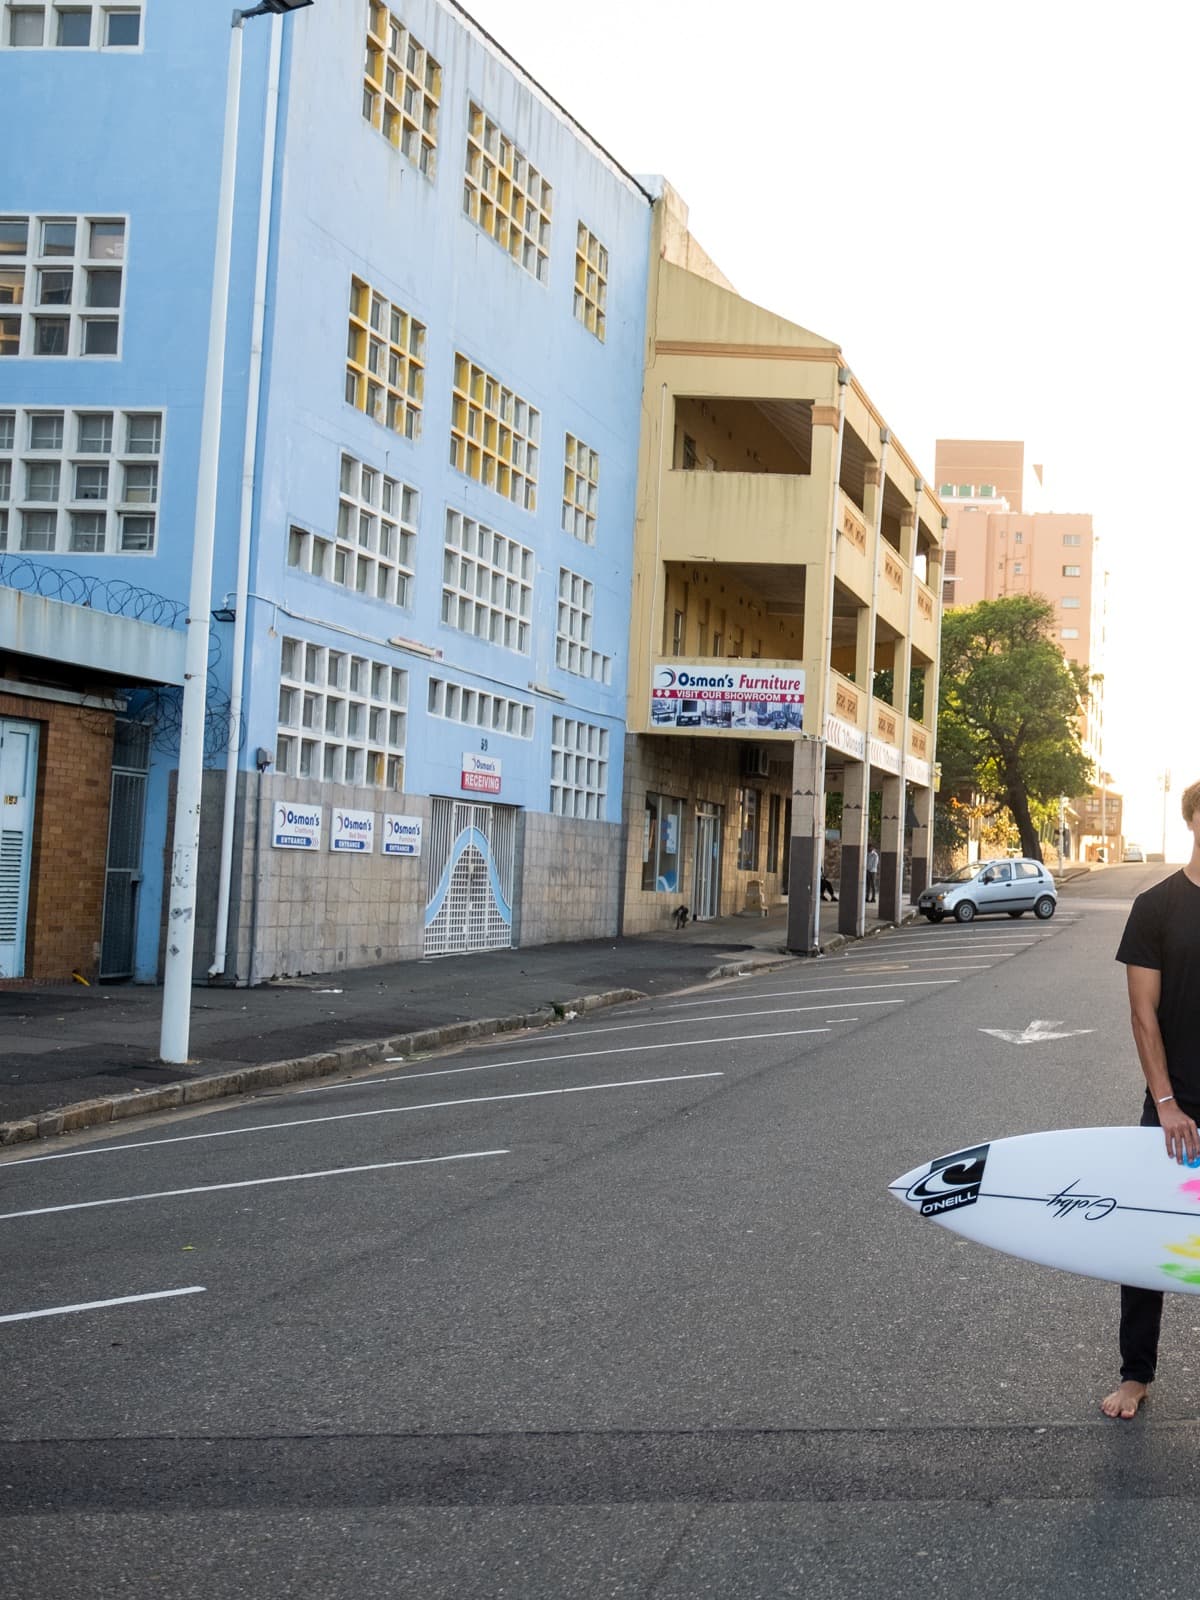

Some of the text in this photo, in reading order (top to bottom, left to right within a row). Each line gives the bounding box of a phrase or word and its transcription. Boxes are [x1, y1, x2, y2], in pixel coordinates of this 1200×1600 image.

[678, 672, 801, 690] Osman's Furniture
[676, 690, 781, 701] VISIT OUR SHOWROOM
[464, 773, 500, 790] RECEIVING
[287, 811, 320, 826] Osman's
[344, 817, 371, 831] Osman's
[393, 821, 421, 836] Osman's
[281, 837, 306, 845] ENTRANCE
[338, 840, 361, 849] ENTRANCE
[388, 844, 410, 852] ENTRANCE
[922, 1191, 977, 1214] O'NEILL
